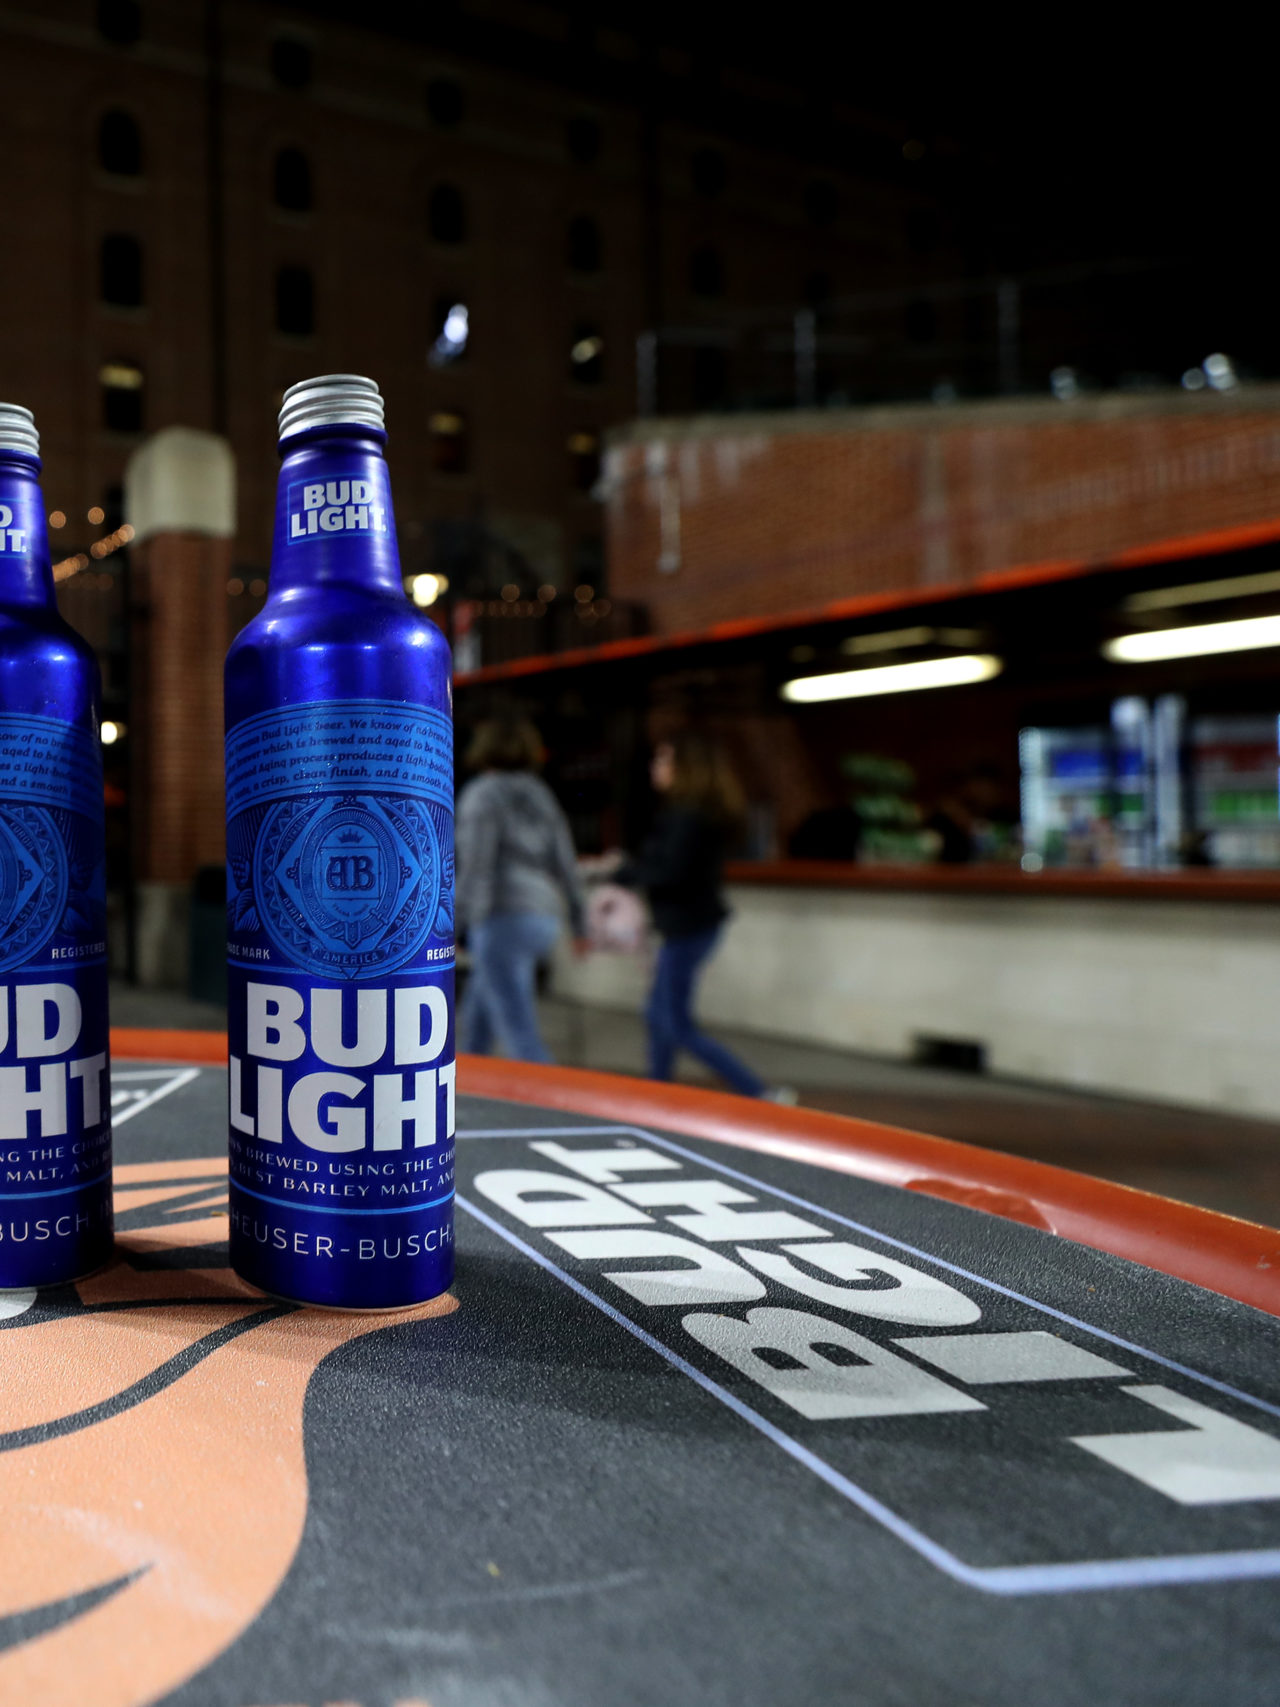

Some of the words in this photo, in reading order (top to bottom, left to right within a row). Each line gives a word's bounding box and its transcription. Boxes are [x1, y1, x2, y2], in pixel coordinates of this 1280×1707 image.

[303, 480, 377, 510] BUD
[291, 505, 386, 538] LIGHT
[349, 719, 368, 729] We
[369, 719, 401, 731] know
[403, 722, 416, 735] of
[21, 732, 35, 745] of
[35, 736, 49, 745] no
[309, 733, 355, 748] brewed
[358, 734, 383, 745] and
[385, 736, 412, 749] aged
[413, 739, 423, 750] to
[424, 741, 434, 754] be
[1, 746, 31, 758] aged
[32, 748, 44, 759] to
[337, 749, 394, 762] produces
[395, 755, 404, 763] a
[13, 763, 22, 772] a
[292, 769, 327, 781] clean
[330, 765, 372, 779] finish,
[375, 767, 400, 779] and
[401, 771, 409, 780] a
[410, 772, 441, 789] smooth
[19, 779, 28, 788] a
[29, 780, 69, 796] smooth
[394, 898, 416, 928] ASIA
[242, 944, 271, 960] MARK
[321, 951, 381, 965] AMERICA
[247, 982, 448, 1068] BUD
[230, 1054, 456, 1153] LIGHT
[28, 1146, 65, 1161] THE
[247, 1149, 319, 1173] BREWED
[329, 1162, 396, 1177] USING
[403, 1156, 434, 1174] THE
[6, 1166, 64, 1183] MALT,
[283, 1177, 370, 1198] BARLEY
[381, 1178, 434, 1197] MALT,
[473, 1168, 989, 1421] BUD
[528, 1140, 1280, 1506] LIGHT
